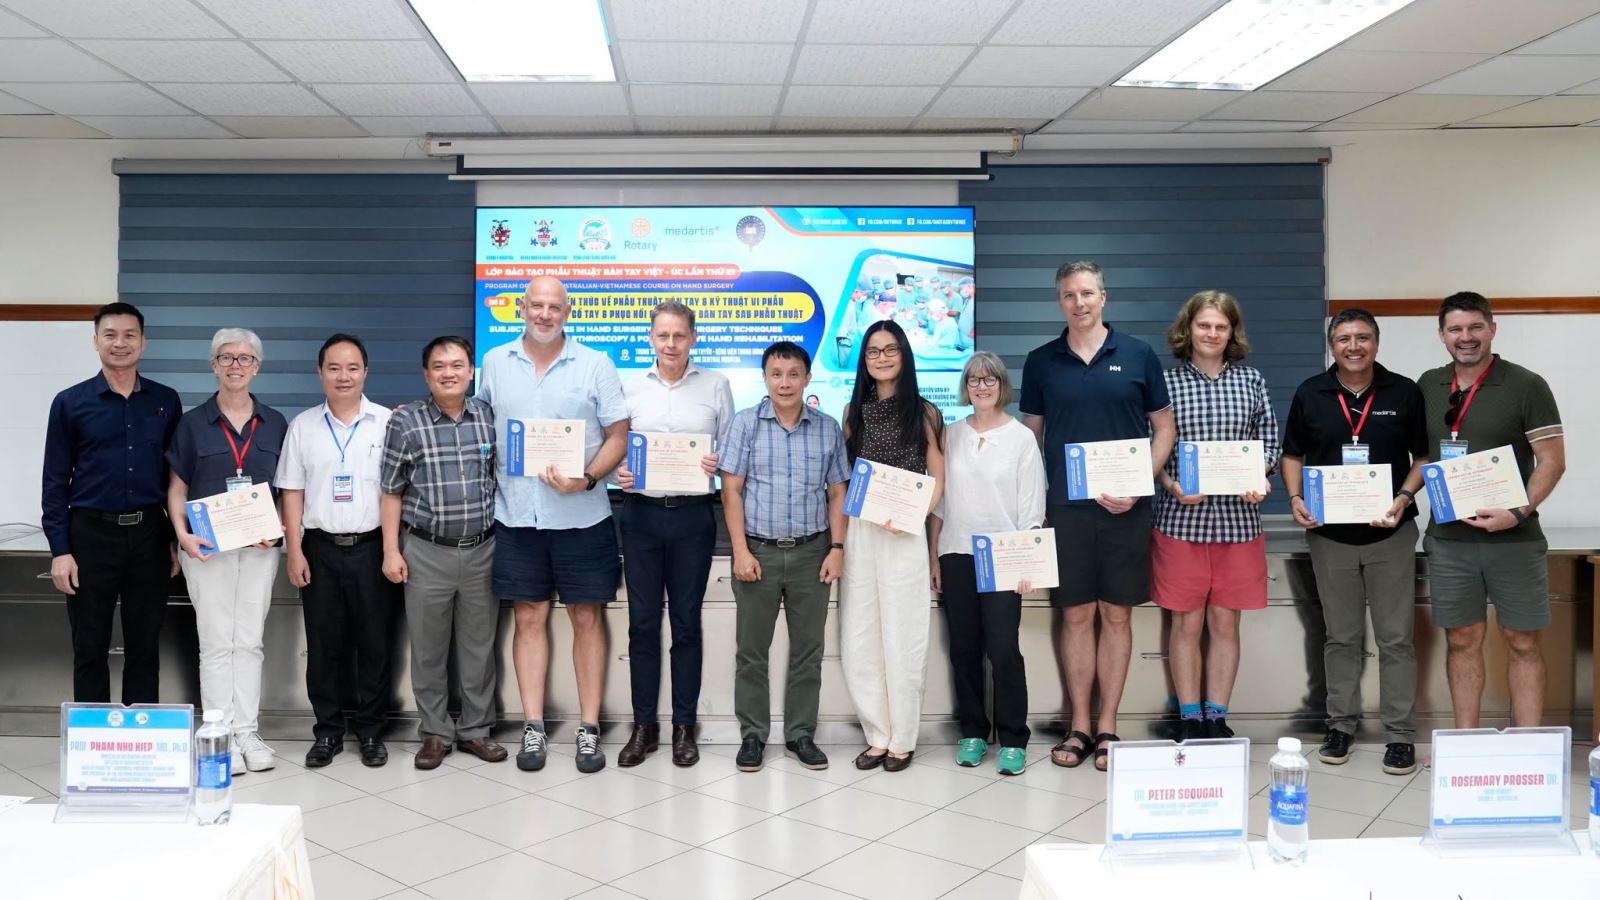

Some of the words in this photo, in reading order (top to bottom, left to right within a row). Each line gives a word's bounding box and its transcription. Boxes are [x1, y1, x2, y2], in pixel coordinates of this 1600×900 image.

[624, 240, 658, 252] Rotary
[485, 266, 503, 276] LỚP
[526, 268, 544, 277] TẠO
[572, 266, 602, 278] THUẬT
[624, 268, 642, 276] TAY
[643, 266, 664, 277] VIỆT
[684, 297, 699, 306] TAY
[751, 297, 760, 306] VI
[584, 309, 600, 319] TAY
[718, 310, 733, 319] TAY
[735, 310, 752, 319] SAU
[576, 325, 585, 333] IN
[586, 325, 612, 333] HAND
[613, 325, 651, 333] SURGERY
[730, 325, 783, 333] TECHNIQUES
[571, 335, 628, 343] RTHROSCOPY
[708, 335, 732, 343] HAND
[734, 335, 804, 343] REHABILITATION
[1451, 775, 1501, 787] ROSEMARY
[1503, 774, 1544, 786] PROSSER
[1148, 788, 1176, 800] PETER
[1277, 801, 1304, 810] AQUAFINA
